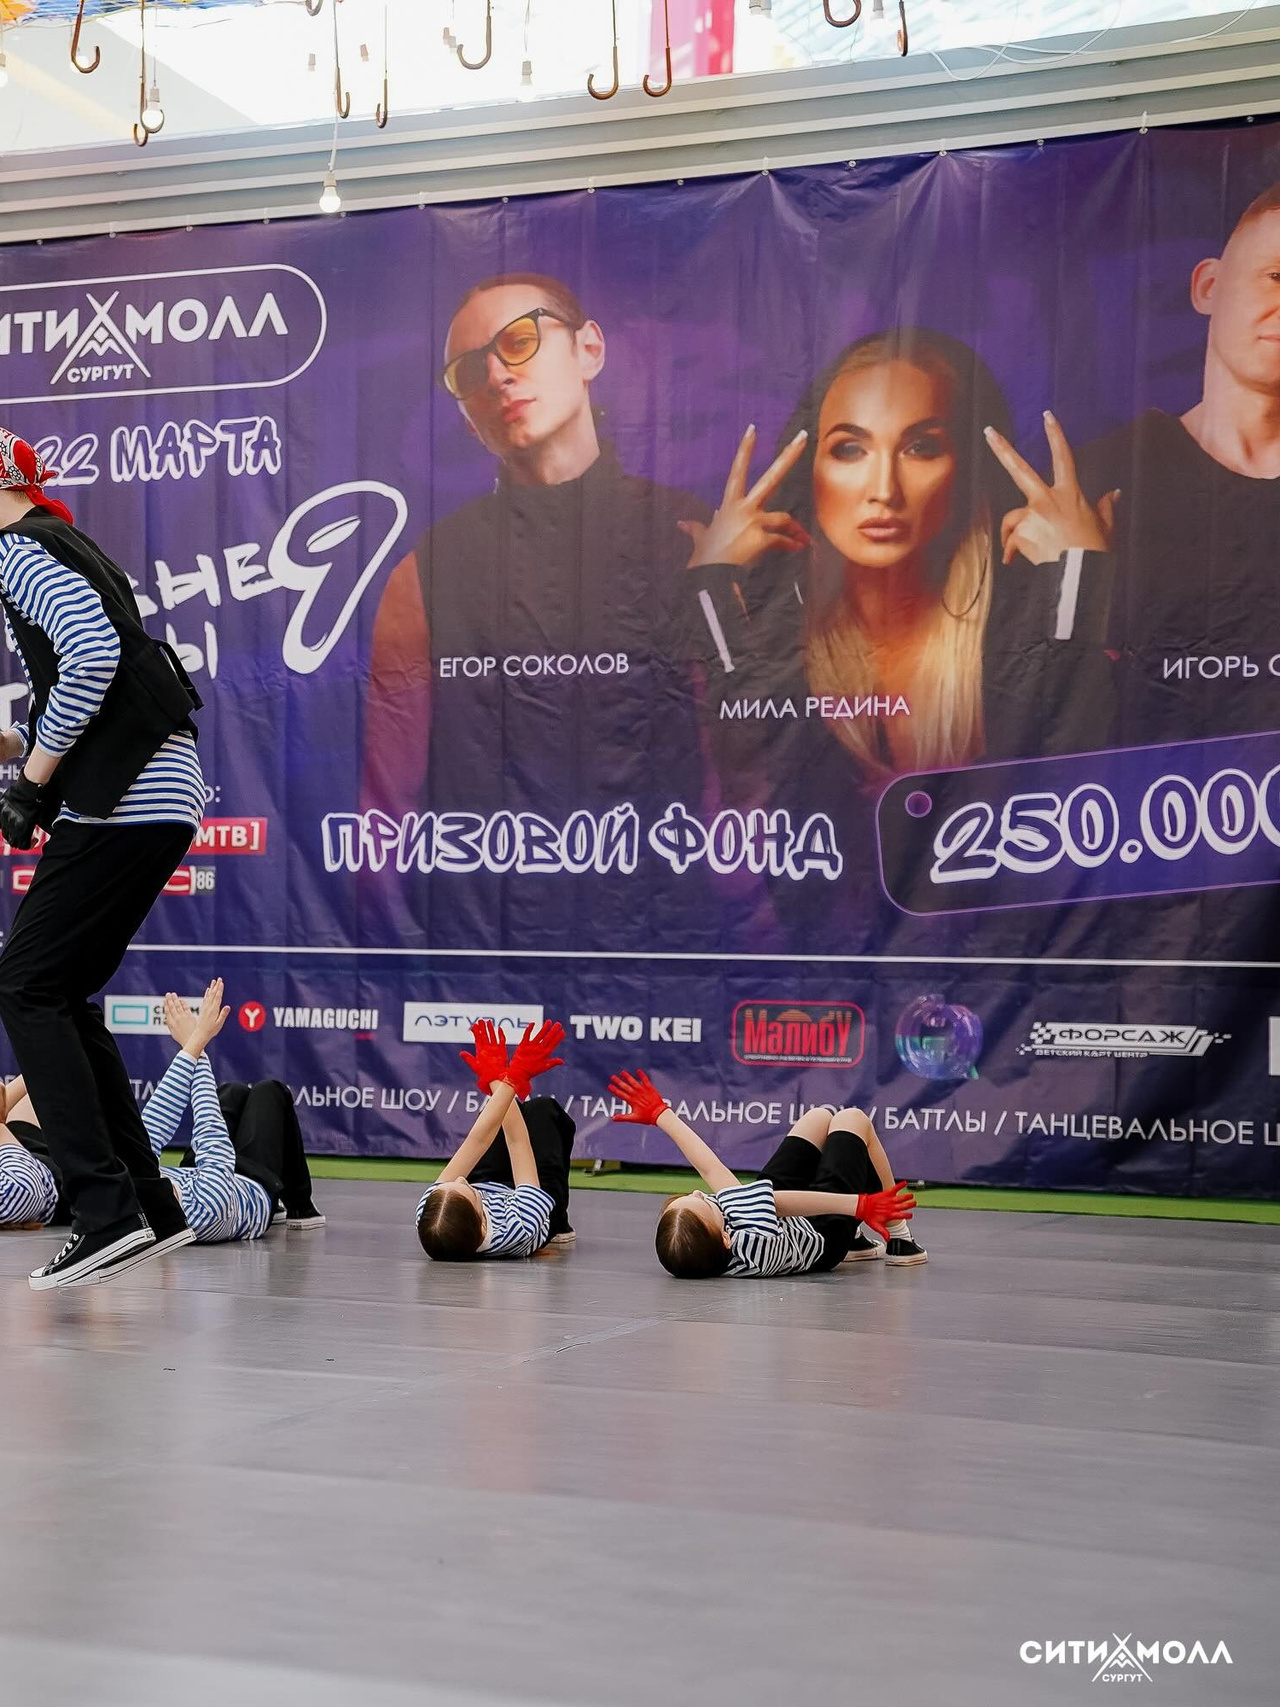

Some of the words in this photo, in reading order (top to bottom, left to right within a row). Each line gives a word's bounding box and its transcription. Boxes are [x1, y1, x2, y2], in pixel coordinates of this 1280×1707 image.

[126, 292, 289, 345] МОЛЛ
[67, 363, 134, 383] СУРГУТ
[110, 415, 282, 484] МАРТА
[439, 656, 498, 678] ЕГОР
[502, 652, 630, 677] СОКОЛОВ
[1163, 655, 1260, 679] ИГОРЬ
[720, 696, 798, 719] МИЛА
[806, 695, 911, 719] РЕДИНА
[321, 801, 640, 875] ПРИЗОВОЙ
[648, 800, 843, 881] ФОНД
[273, 1006, 379, 1030] YAMAGUCHI
[570, 1014, 644, 1040] TWO
[650, 1016, 702, 1043] KEI
[1058, 1028, 1187, 1044] ФОРСАЖ
[381, 1087, 442, 1112] ШОУ
[884, 1106, 986, 1133] БАТТЛЫ
[1014, 1111, 1254, 1145] ТАНЦЕВАЛЬНОЕ
